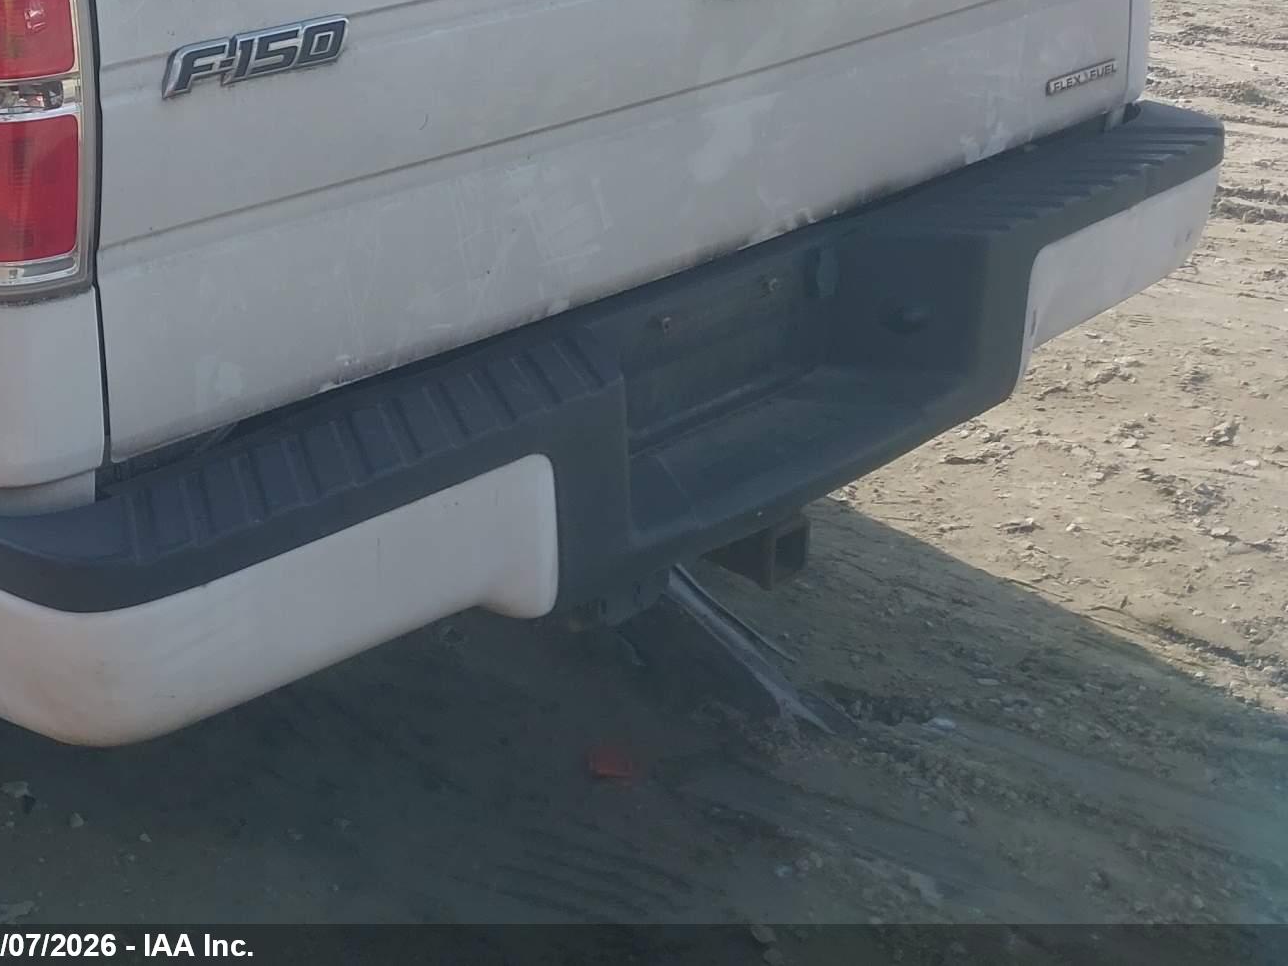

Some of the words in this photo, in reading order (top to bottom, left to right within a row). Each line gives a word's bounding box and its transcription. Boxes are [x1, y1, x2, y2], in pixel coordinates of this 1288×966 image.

[162, 14, 349, 99] F-150
[1053, 75, 1082, 90] FLEX
[1090, 64, 1117, 78] FUEL
